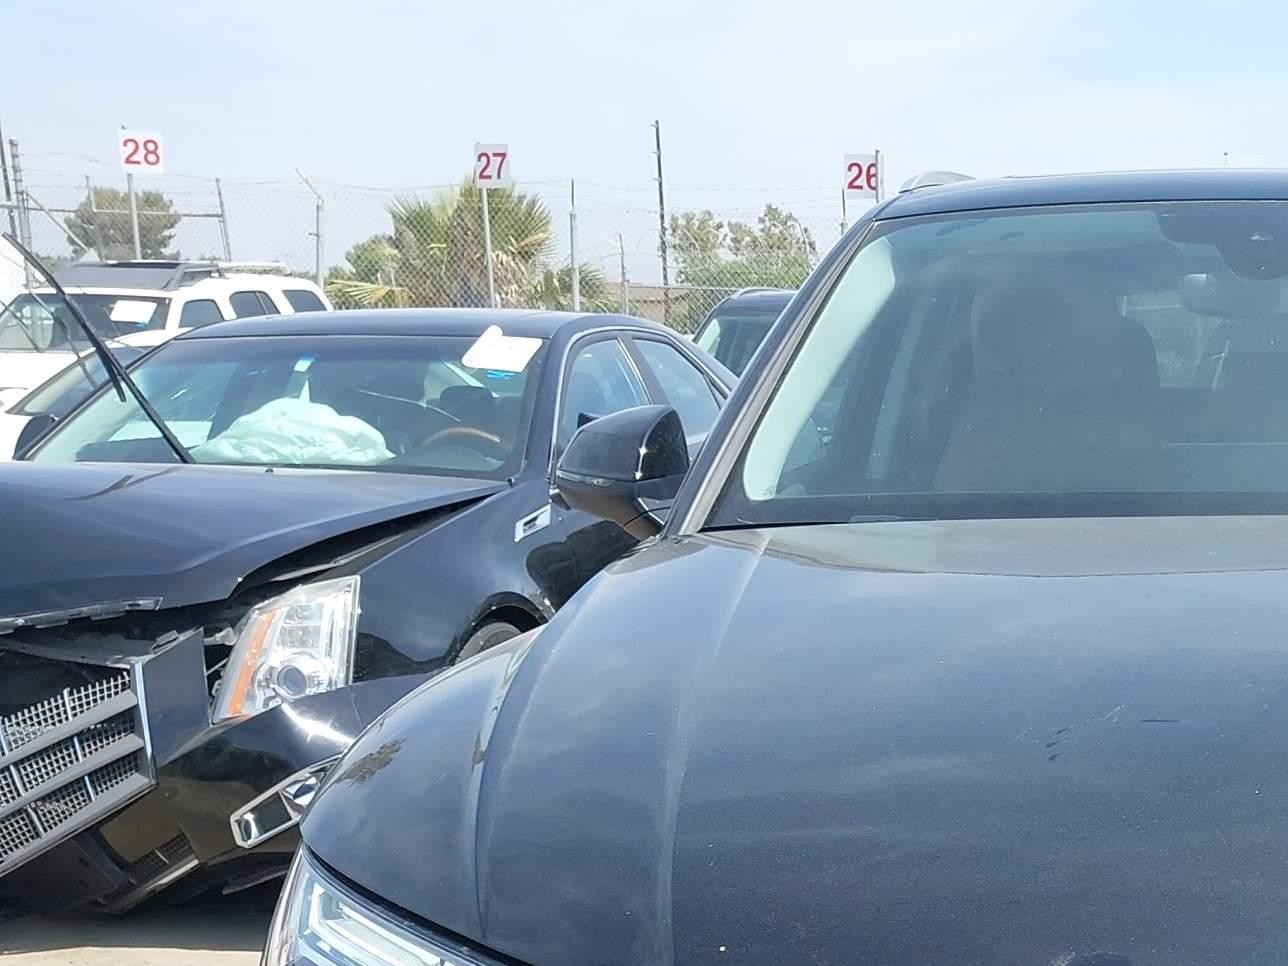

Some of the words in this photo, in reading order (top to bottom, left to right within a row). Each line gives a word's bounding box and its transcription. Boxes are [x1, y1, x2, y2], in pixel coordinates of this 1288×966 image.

[122, 138, 160, 166] 28
[477, 152, 507, 180] 27
[847, 162, 879, 190] 26
